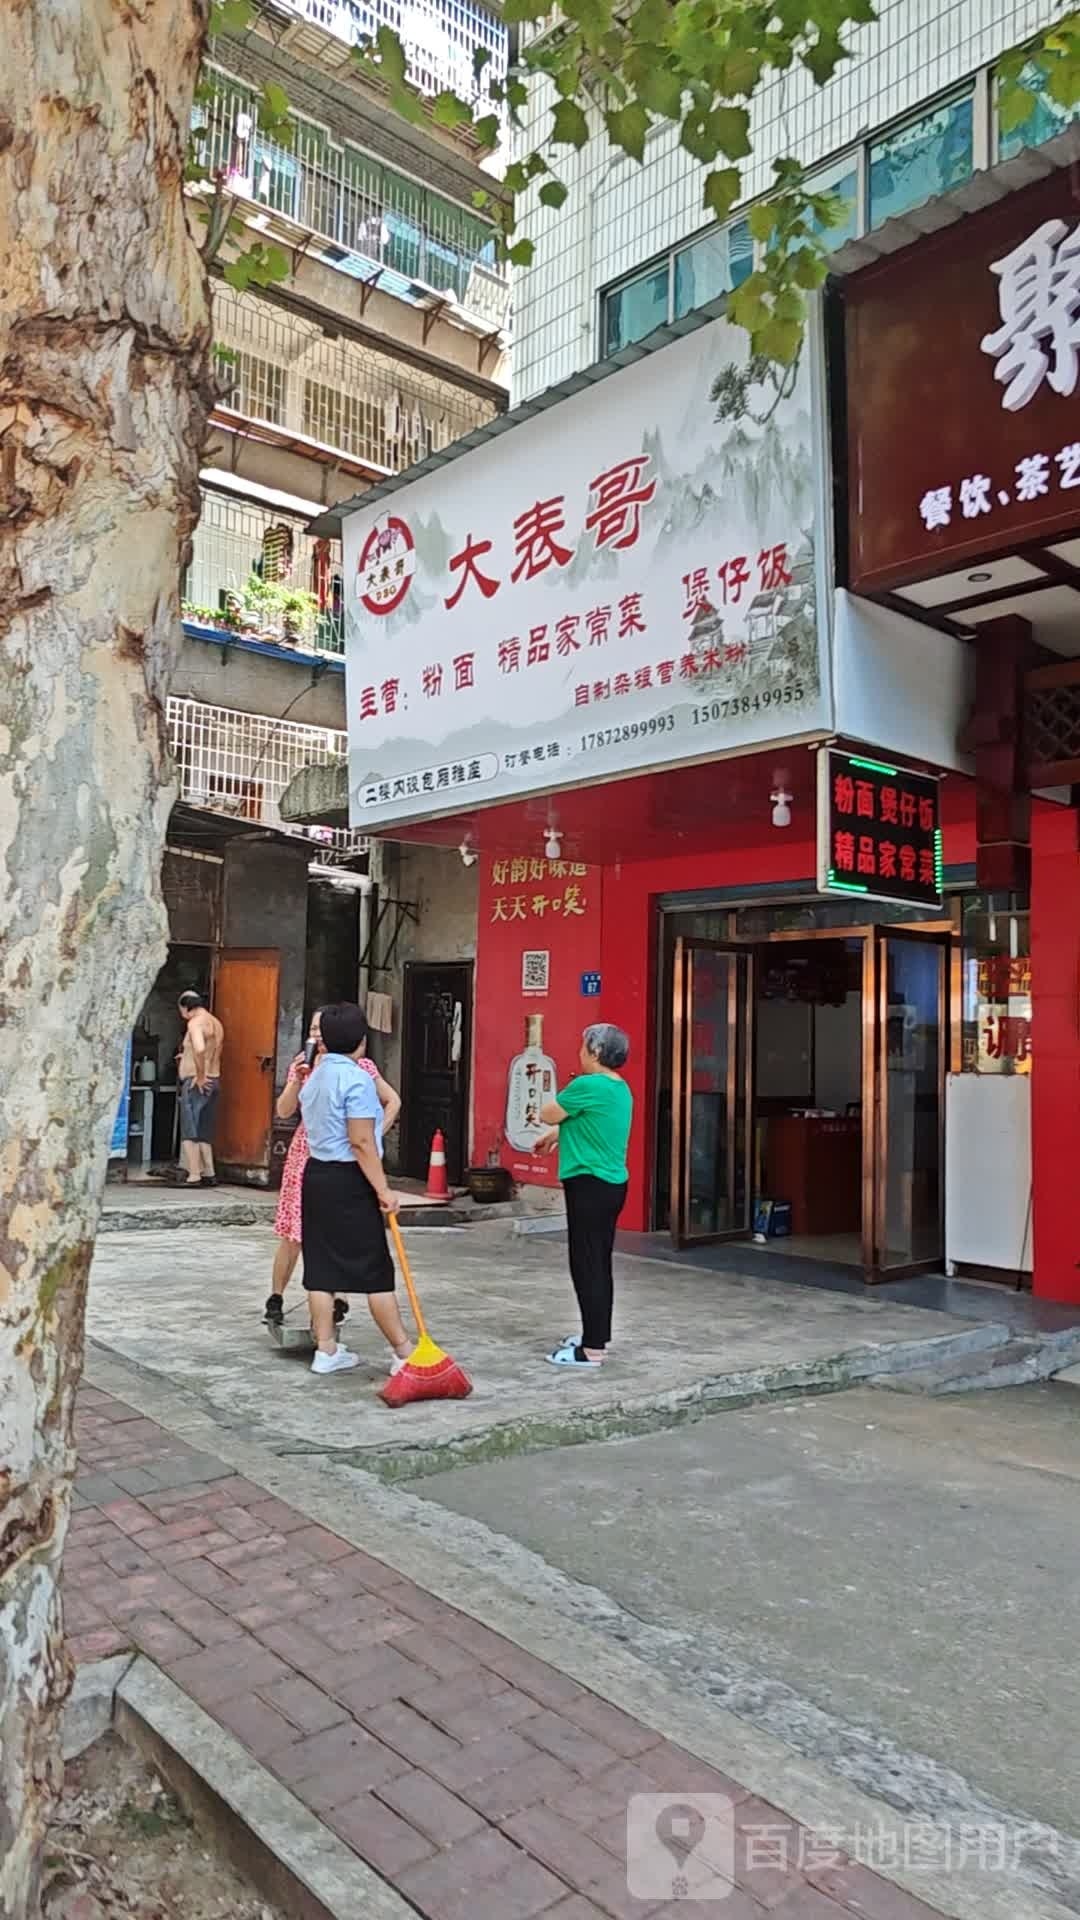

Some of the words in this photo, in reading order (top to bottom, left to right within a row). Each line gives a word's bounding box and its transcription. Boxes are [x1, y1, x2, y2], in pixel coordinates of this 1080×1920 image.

[444, 456, 656, 610] 大表哥
[498, 592, 647, 674] 精品家常菜
[682, 543, 793, 619] 煲仔饭
[581, 714, 675, 751] 17872899993
[692, 683, 804, 726] 15073849955
[835, 831, 934, 885] 精品家常菜
